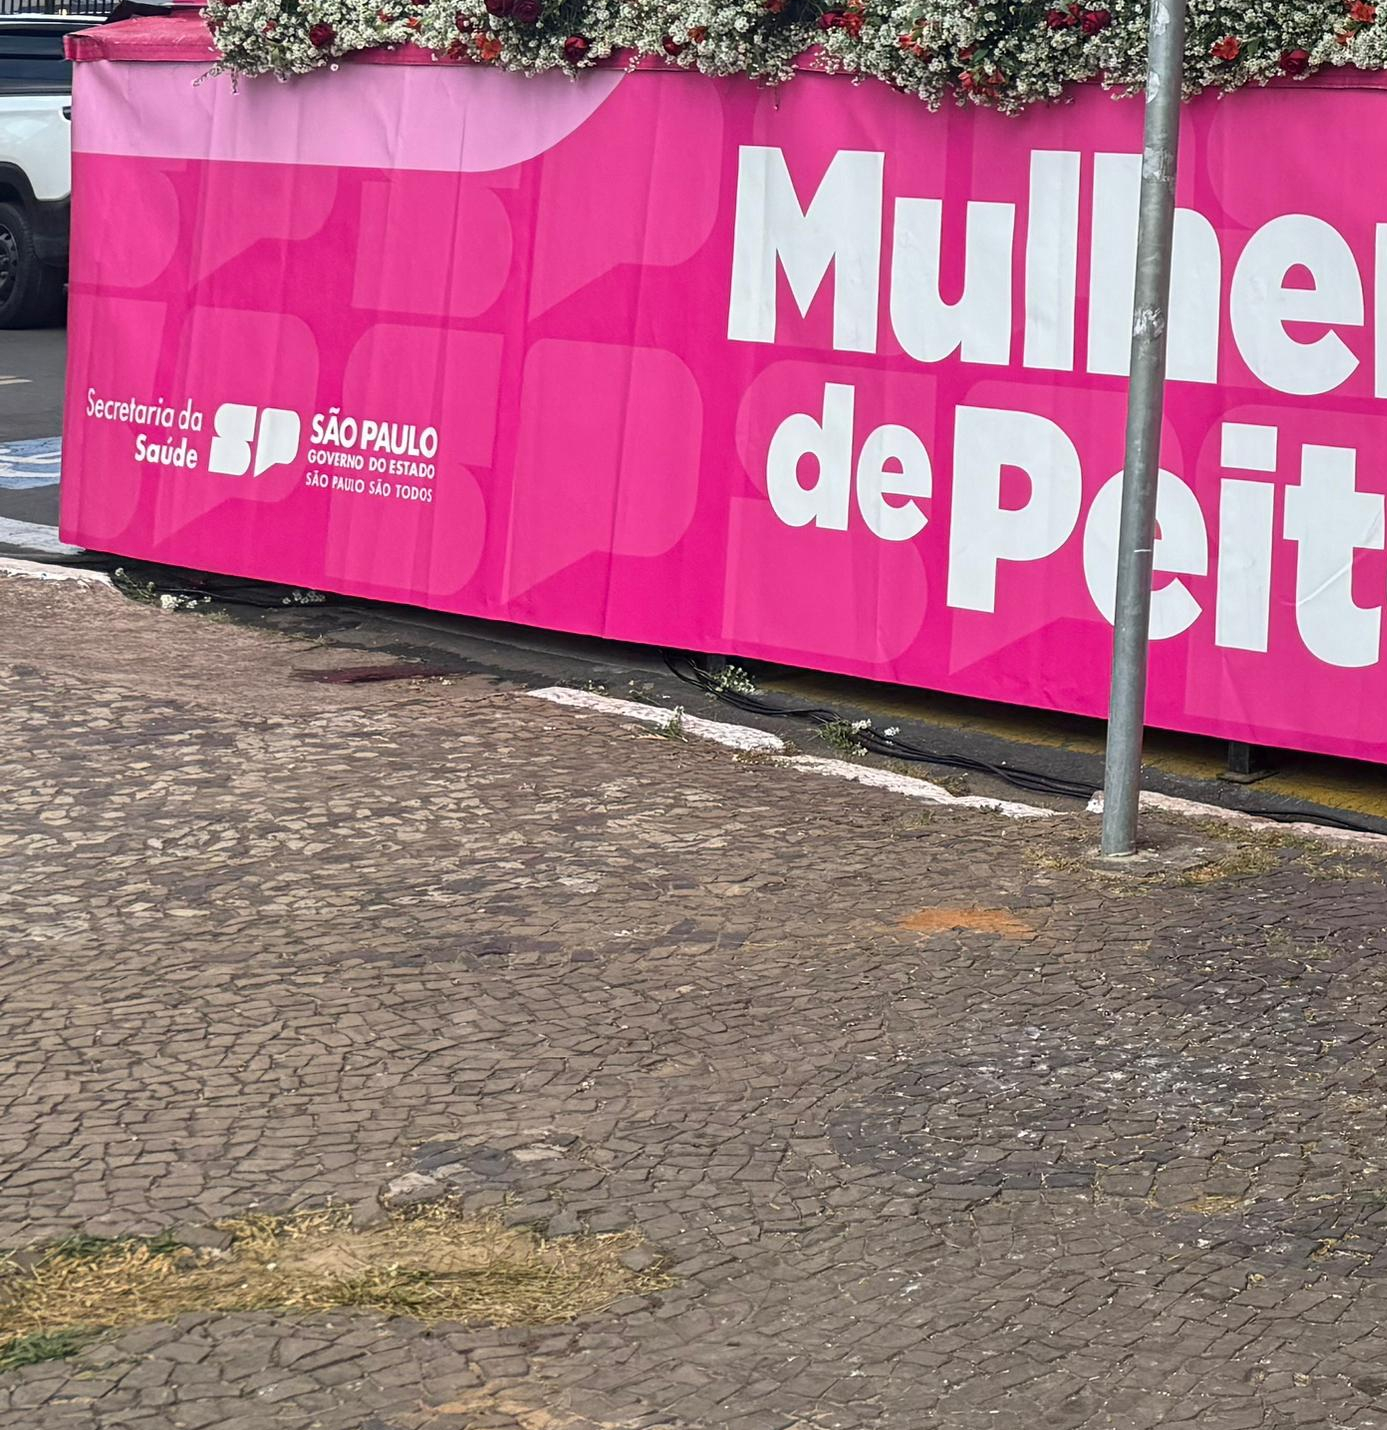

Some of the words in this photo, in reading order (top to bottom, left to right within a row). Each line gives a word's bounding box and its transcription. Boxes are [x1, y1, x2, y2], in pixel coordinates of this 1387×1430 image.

[86, 388, 174, 428] Secretaria
[178, 398, 203, 432] da
[135, 434, 197, 468] Saúde
[310, 408, 357, 449] SÃO
[361, 420, 438, 459] PAULO
[307, 449, 363, 470] GOVERNO
[368, 455, 386, 473] DO
[389, 459, 435, 479] ESTADO
[765, 383, 934, 541] de
[305, 471, 329, 489] SÃO
[332, 475, 364, 493] PAULO
[368, 478, 391, 497] SÃO
[395, 483, 432, 503] TODOS
